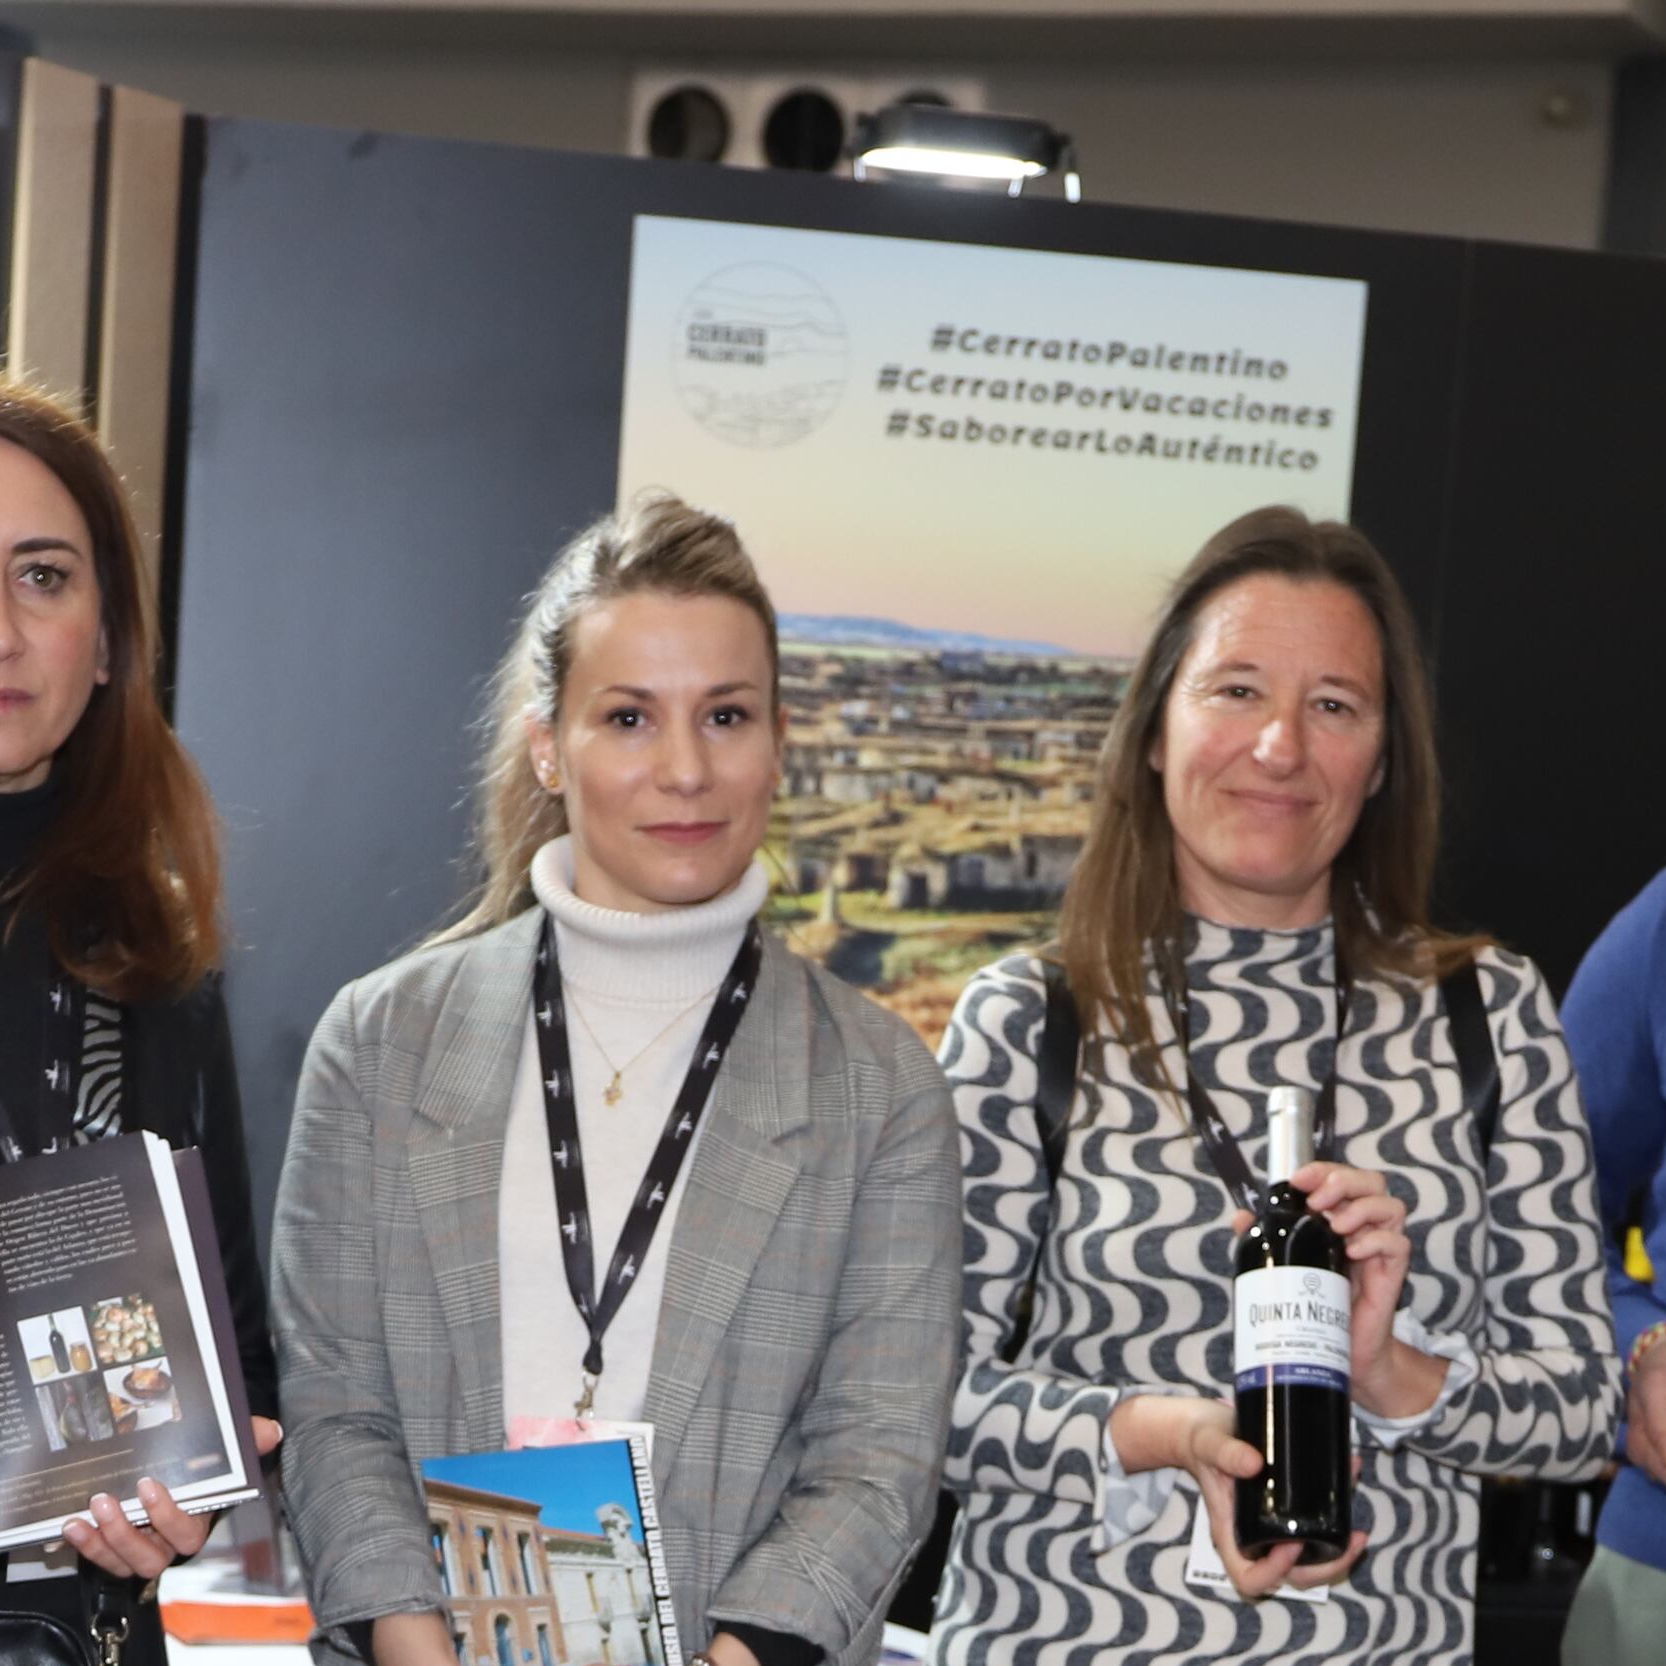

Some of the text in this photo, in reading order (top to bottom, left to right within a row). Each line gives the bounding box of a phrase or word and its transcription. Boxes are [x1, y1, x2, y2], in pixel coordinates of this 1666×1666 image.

[930, 322, 1289, 382] #CerratoPalentino
[877, 363, 1334, 430] #CerratoPorVacaciones
[886, 409, 1320, 472] #SaborearLoAuténtico
[1250, 1300, 1350, 1334] QUINTA NEGRE
[629, 1436, 659, 1529] CASTELLANO
[645, 1529, 671, 1598] CERRATO
